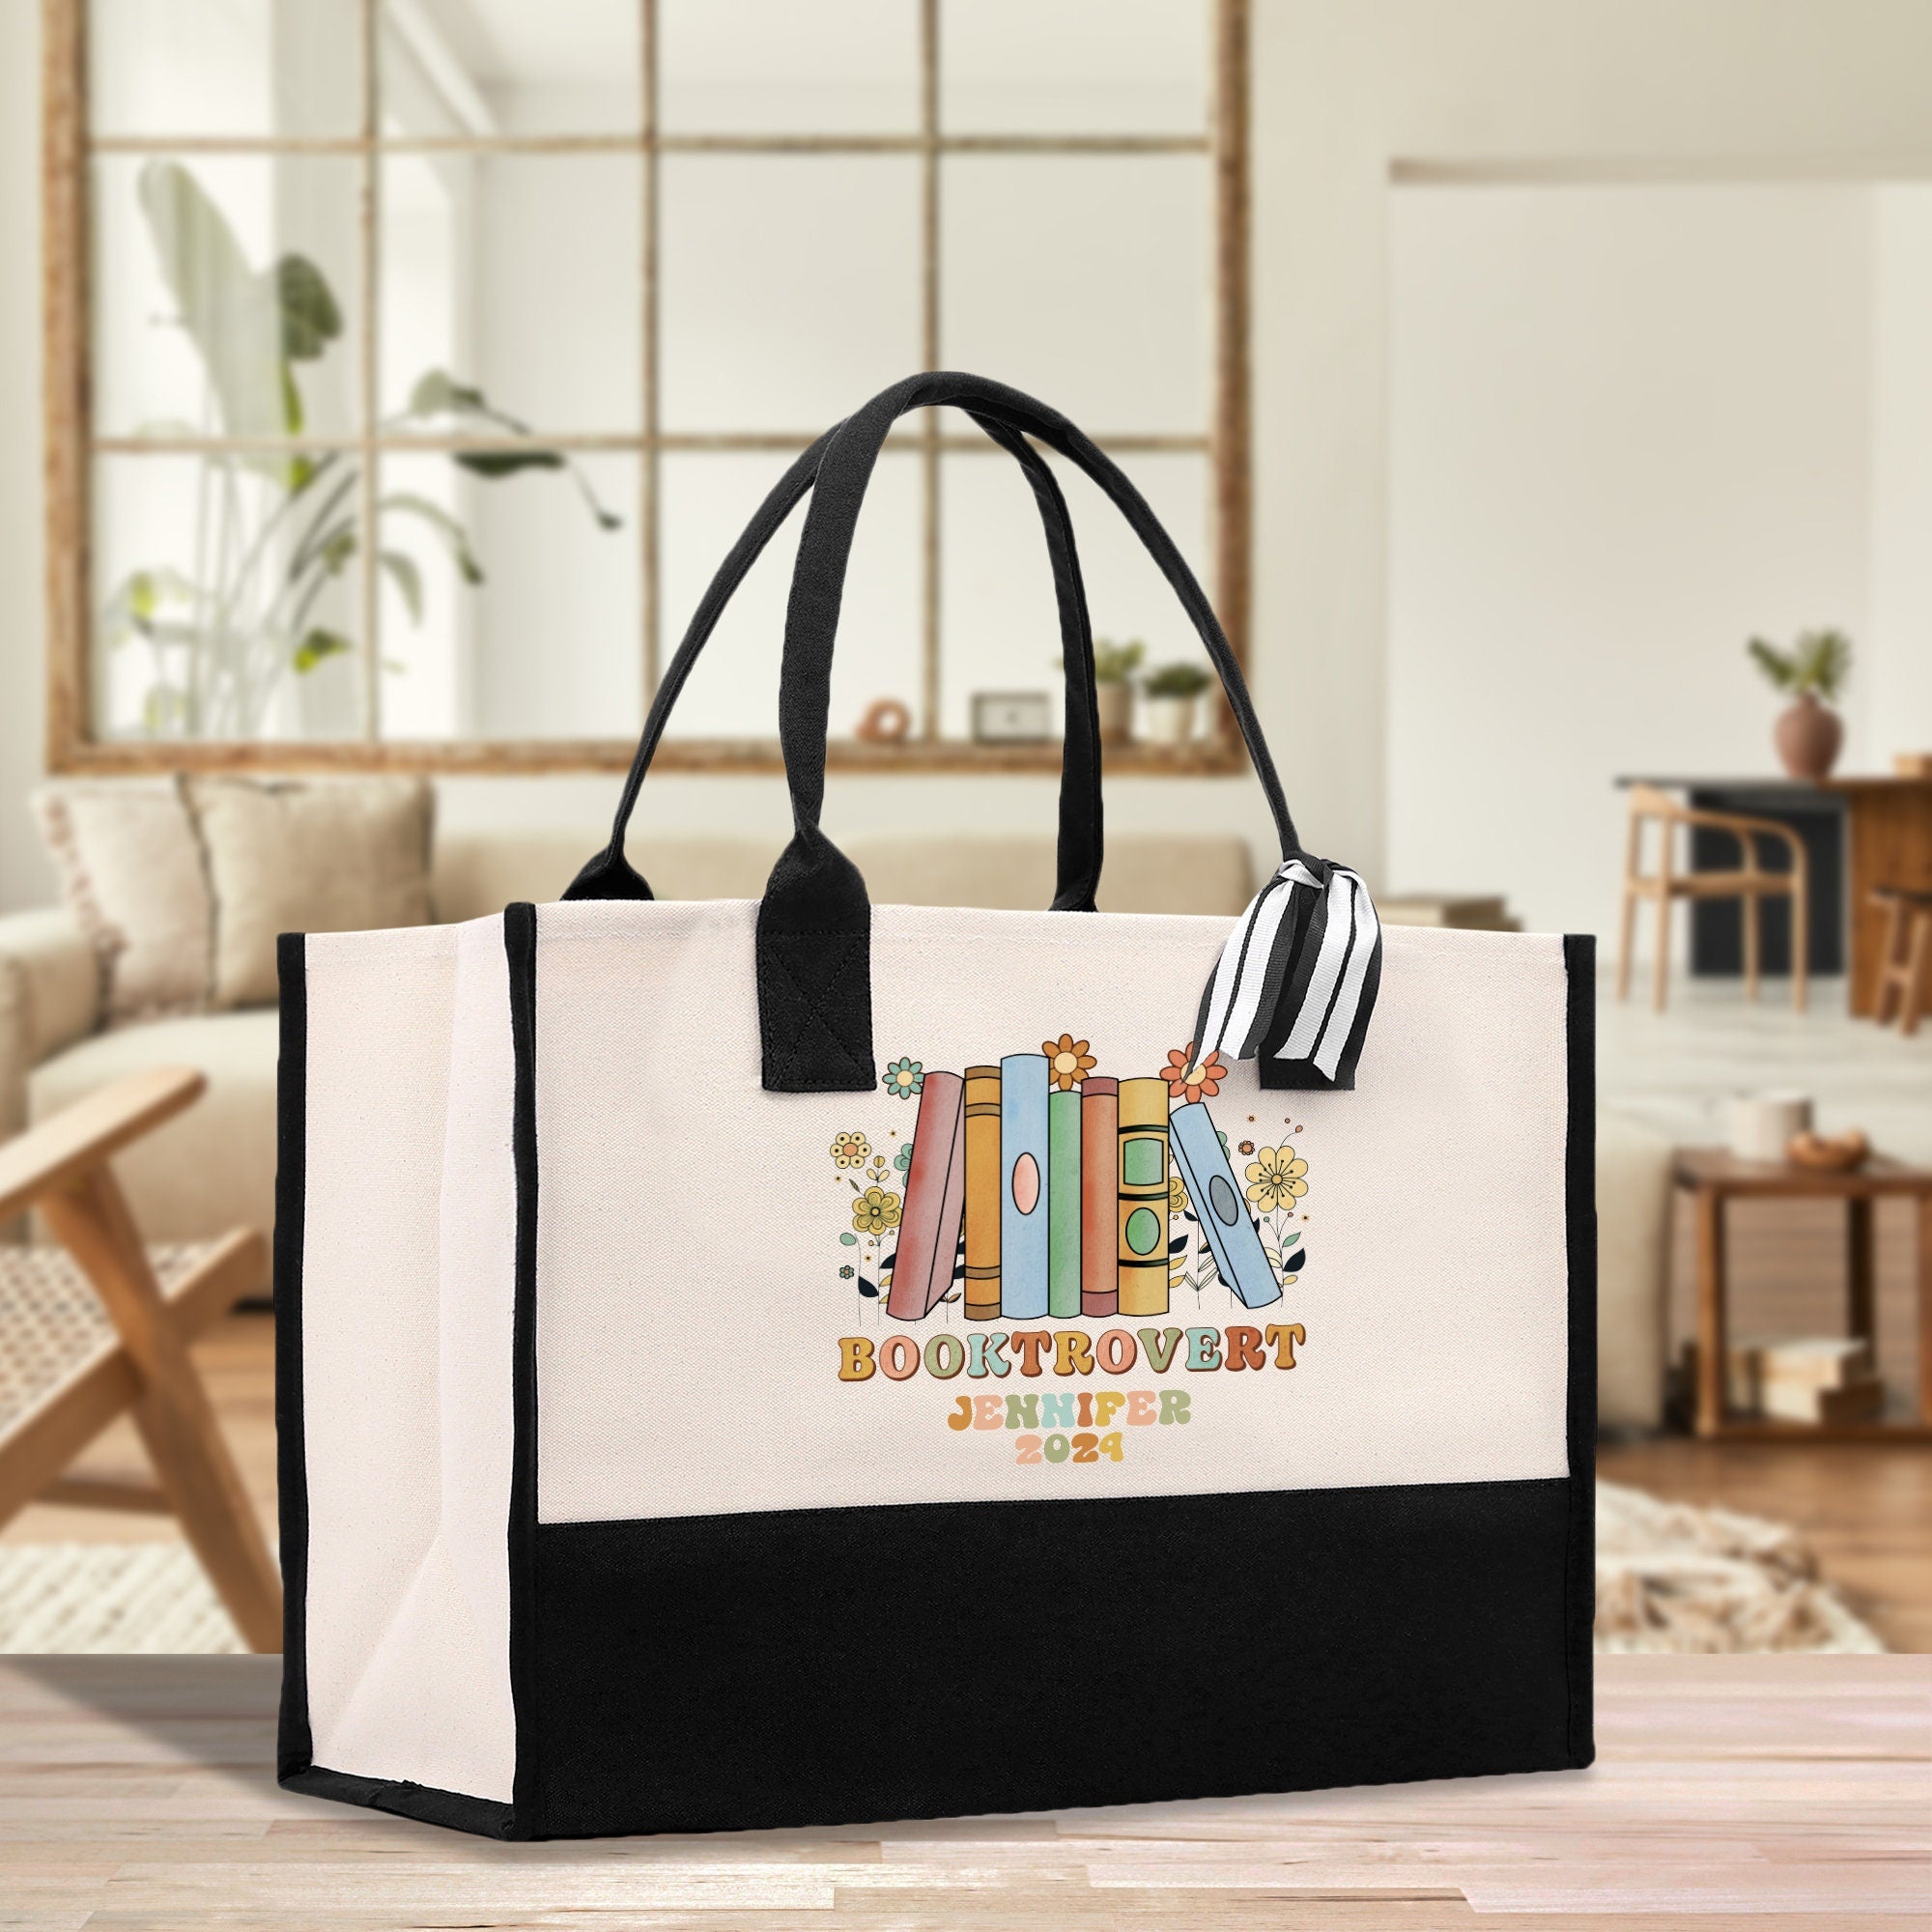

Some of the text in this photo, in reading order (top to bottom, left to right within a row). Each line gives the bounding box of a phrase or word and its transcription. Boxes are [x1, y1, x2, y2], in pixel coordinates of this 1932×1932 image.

[838, 1322, 1306, 1381] BOOKTROVERT
[947, 1389, 1191, 1431] JENNIFER
[1014, 1432, 1124, 1464] 2024
